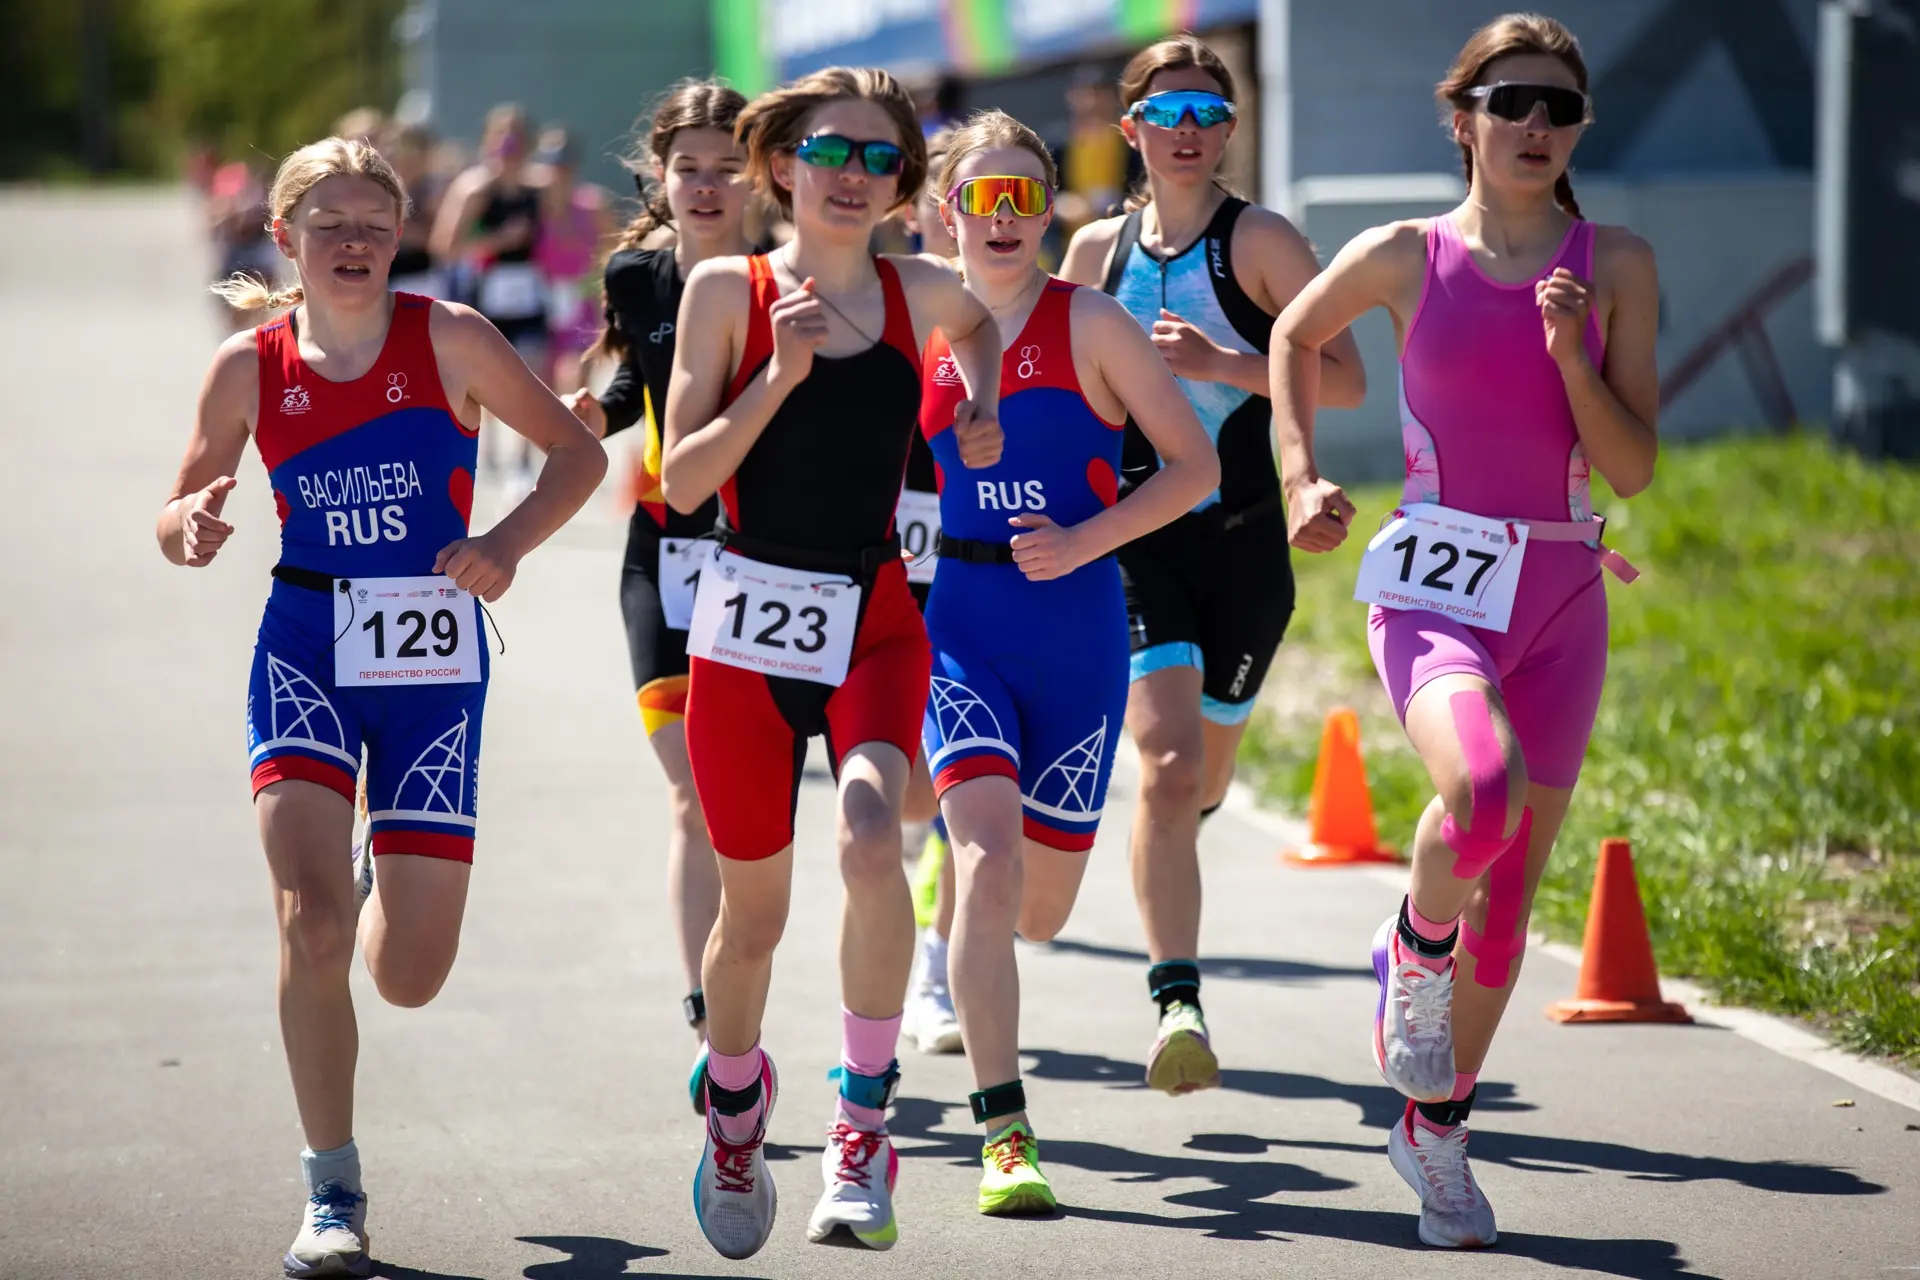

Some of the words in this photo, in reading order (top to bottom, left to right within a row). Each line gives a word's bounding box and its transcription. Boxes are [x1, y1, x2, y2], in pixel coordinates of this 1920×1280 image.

[298, 461, 423, 509] ВАСИЛЬЕВА
[977, 480, 1047, 511] RUS
[325, 505, 407, 546] RUS
[1393, 535, 1498, 596] 127
[724, 592, 827, 654] 123
[1378, 591, 1443, 611] ПЕРВЕНСТВО
[1445, 604, 1486, 620] РОССИИ
[362, 608, 459, 659] 129
[359, 669, 423, 680] ПЕРВЕНСТВО
[425, 667, 461, 677] РОССИИ
[711, 646, 778, 668] ПЕРВЕНСТВО
[779, 661, 823, 674] РОССИИ
